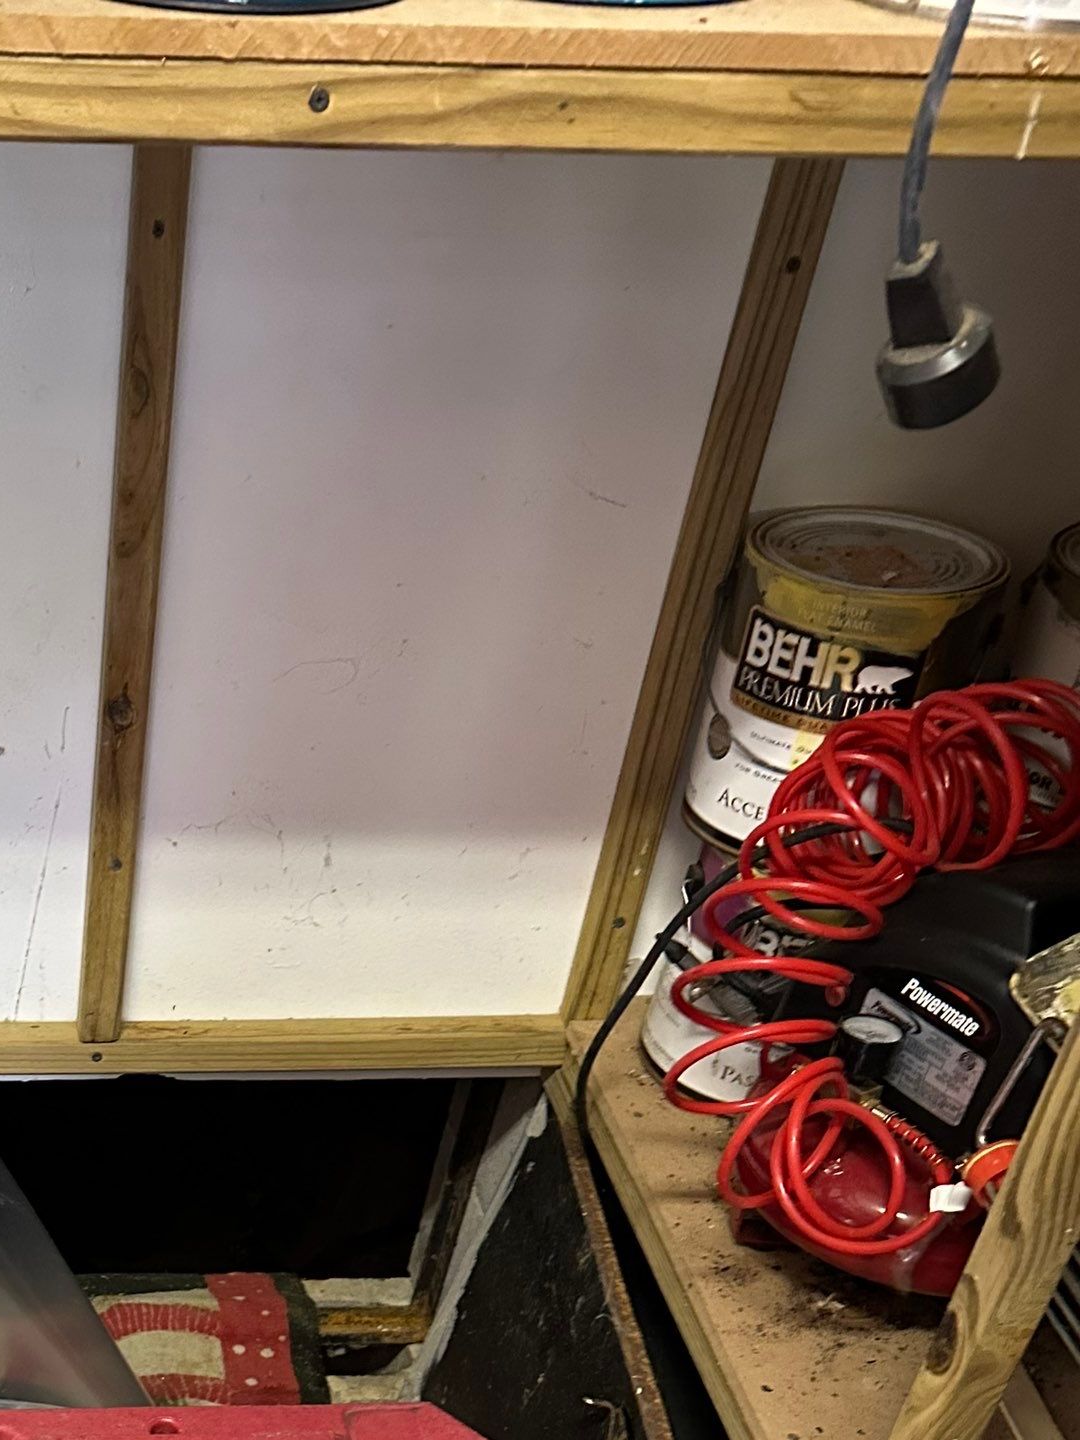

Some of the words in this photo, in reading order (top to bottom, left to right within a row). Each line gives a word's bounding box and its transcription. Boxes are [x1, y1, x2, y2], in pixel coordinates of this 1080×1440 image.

[744, 616, 862, 694] BEHR
[737, 665, 838, 717] PREMIUM
[900, 977, 981, 1037] Powermate
